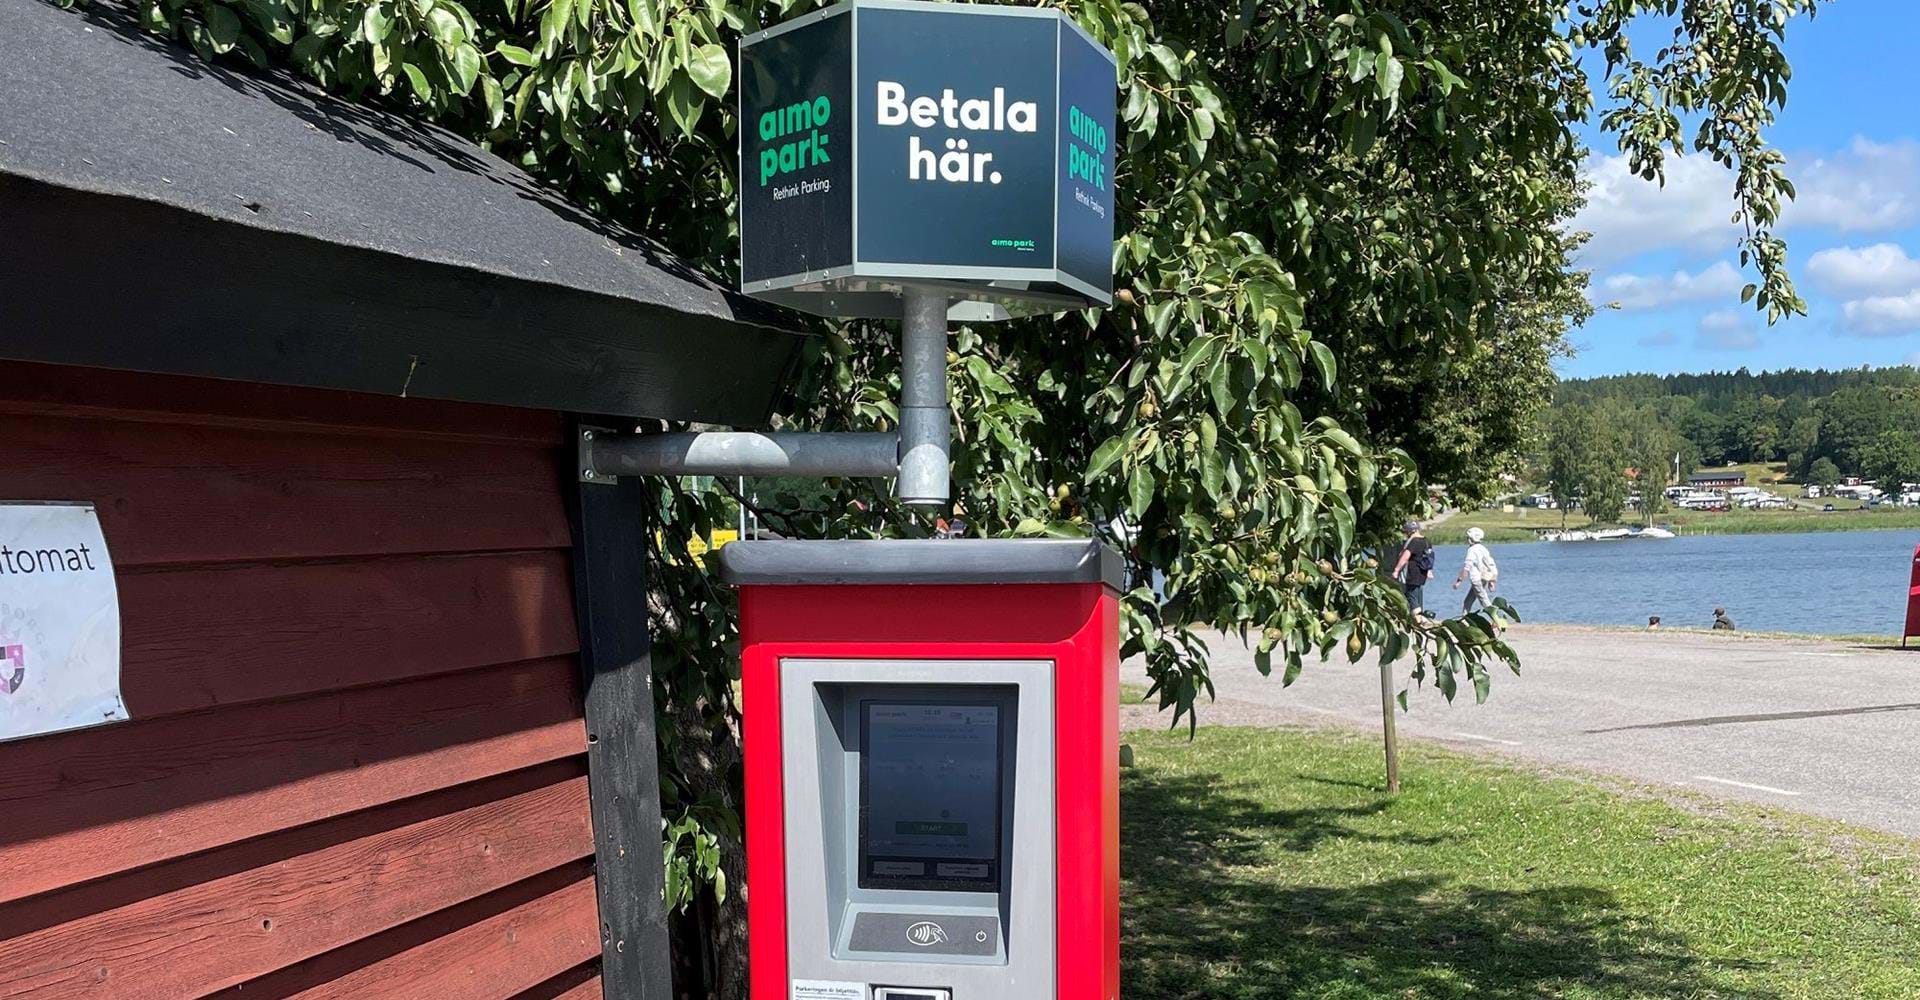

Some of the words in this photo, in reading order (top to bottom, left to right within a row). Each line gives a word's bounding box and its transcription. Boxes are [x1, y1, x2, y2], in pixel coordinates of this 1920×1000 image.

[758, 94, 831, 141] aimo
[876, 80, 1037, 133] Betala
[1069, 105, 1107, 155] aimo
[759, 129, 831, 187] park
[909, 136, 1002, 184] här.
[1069, 142, 1105, 192] park
[773, 183, 800, 201] Rethink
[801, 178, 832, 193] Parking.
[1013, 239, 1035, 248] park
[0, 542, 96, 574] tomat
